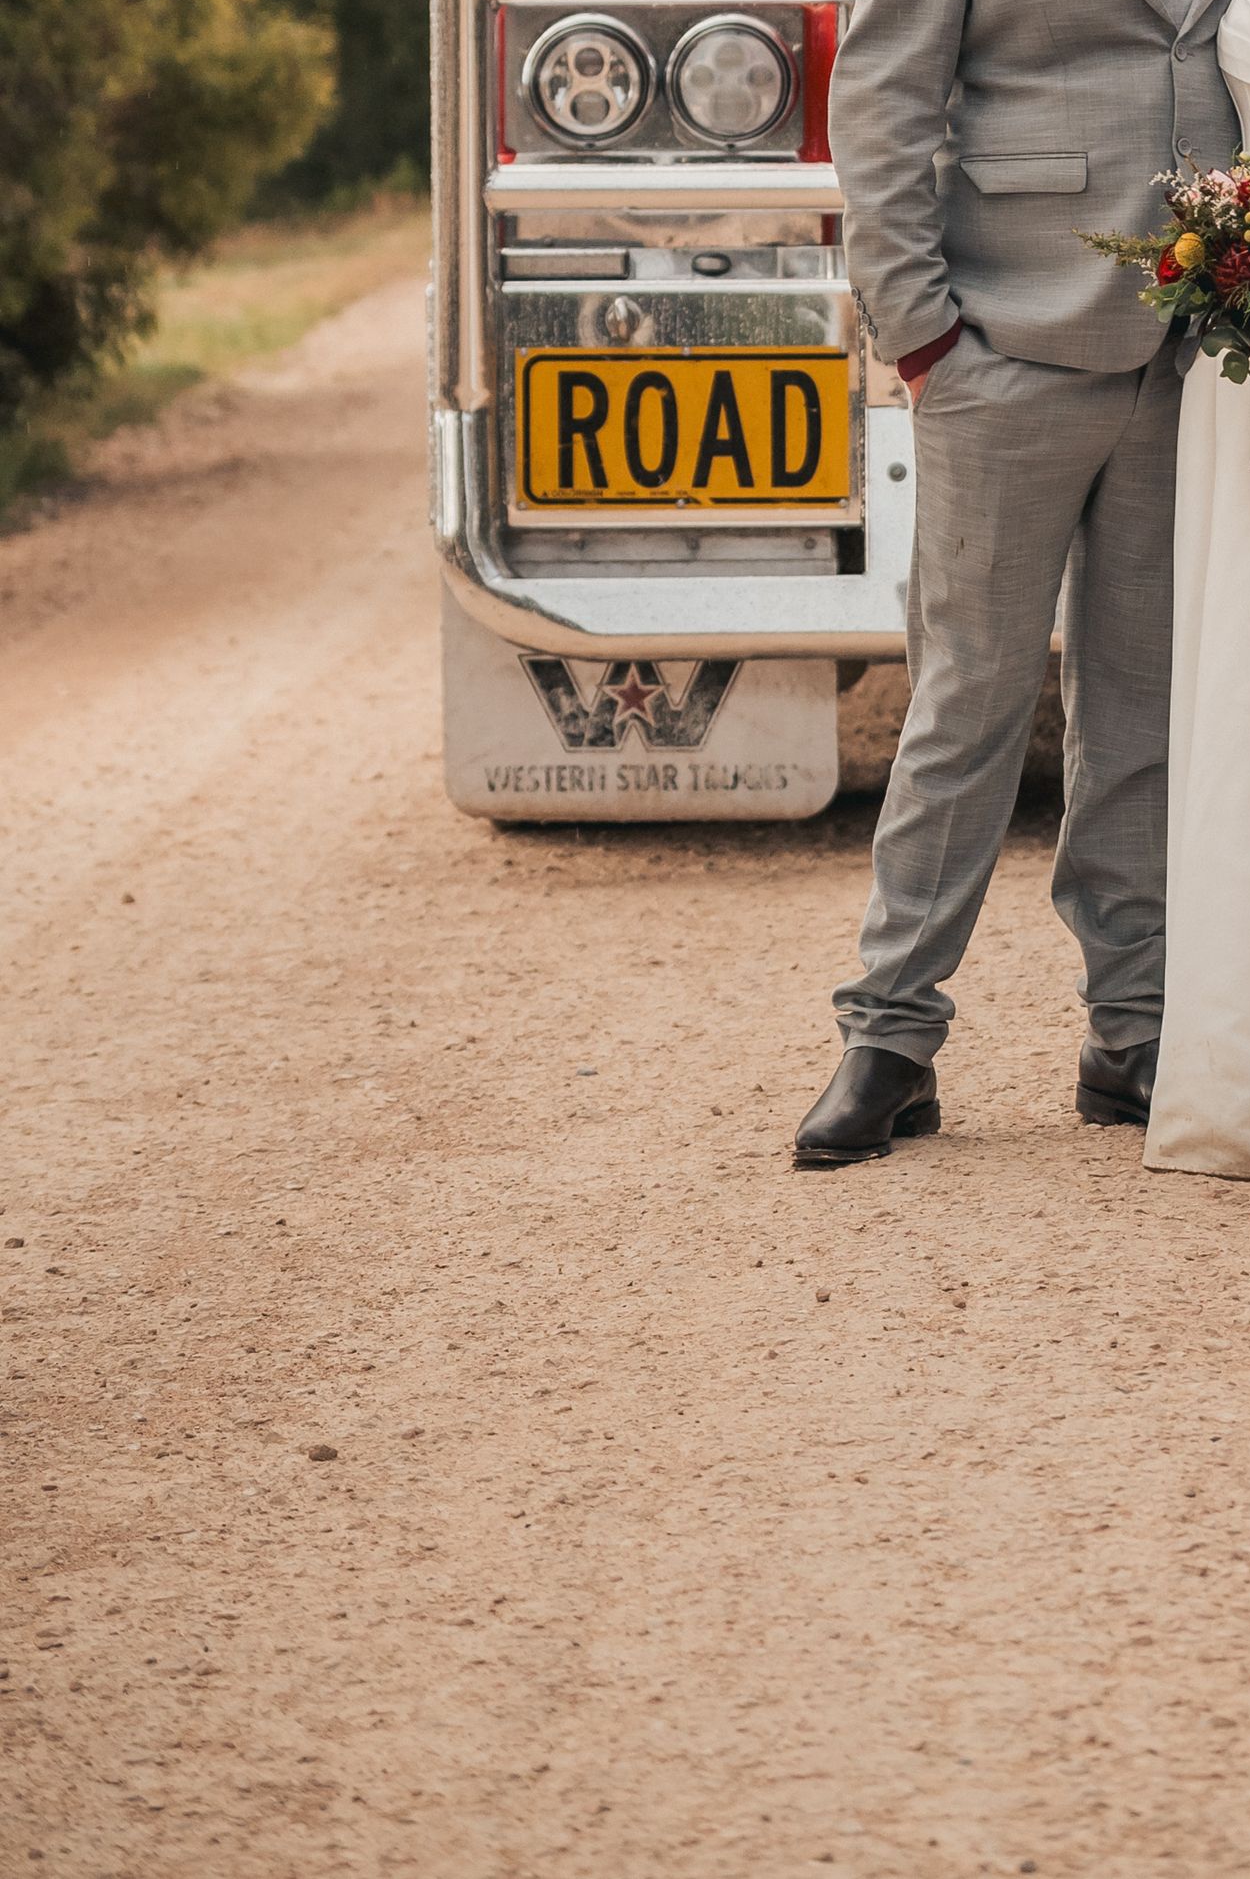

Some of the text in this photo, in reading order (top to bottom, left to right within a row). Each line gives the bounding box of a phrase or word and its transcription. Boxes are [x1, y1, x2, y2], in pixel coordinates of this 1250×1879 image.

[557, 369, 822, 489] ROAD
[484, 764, 607, 793] WESTERN
[616, 764, 679, 793] STAR
